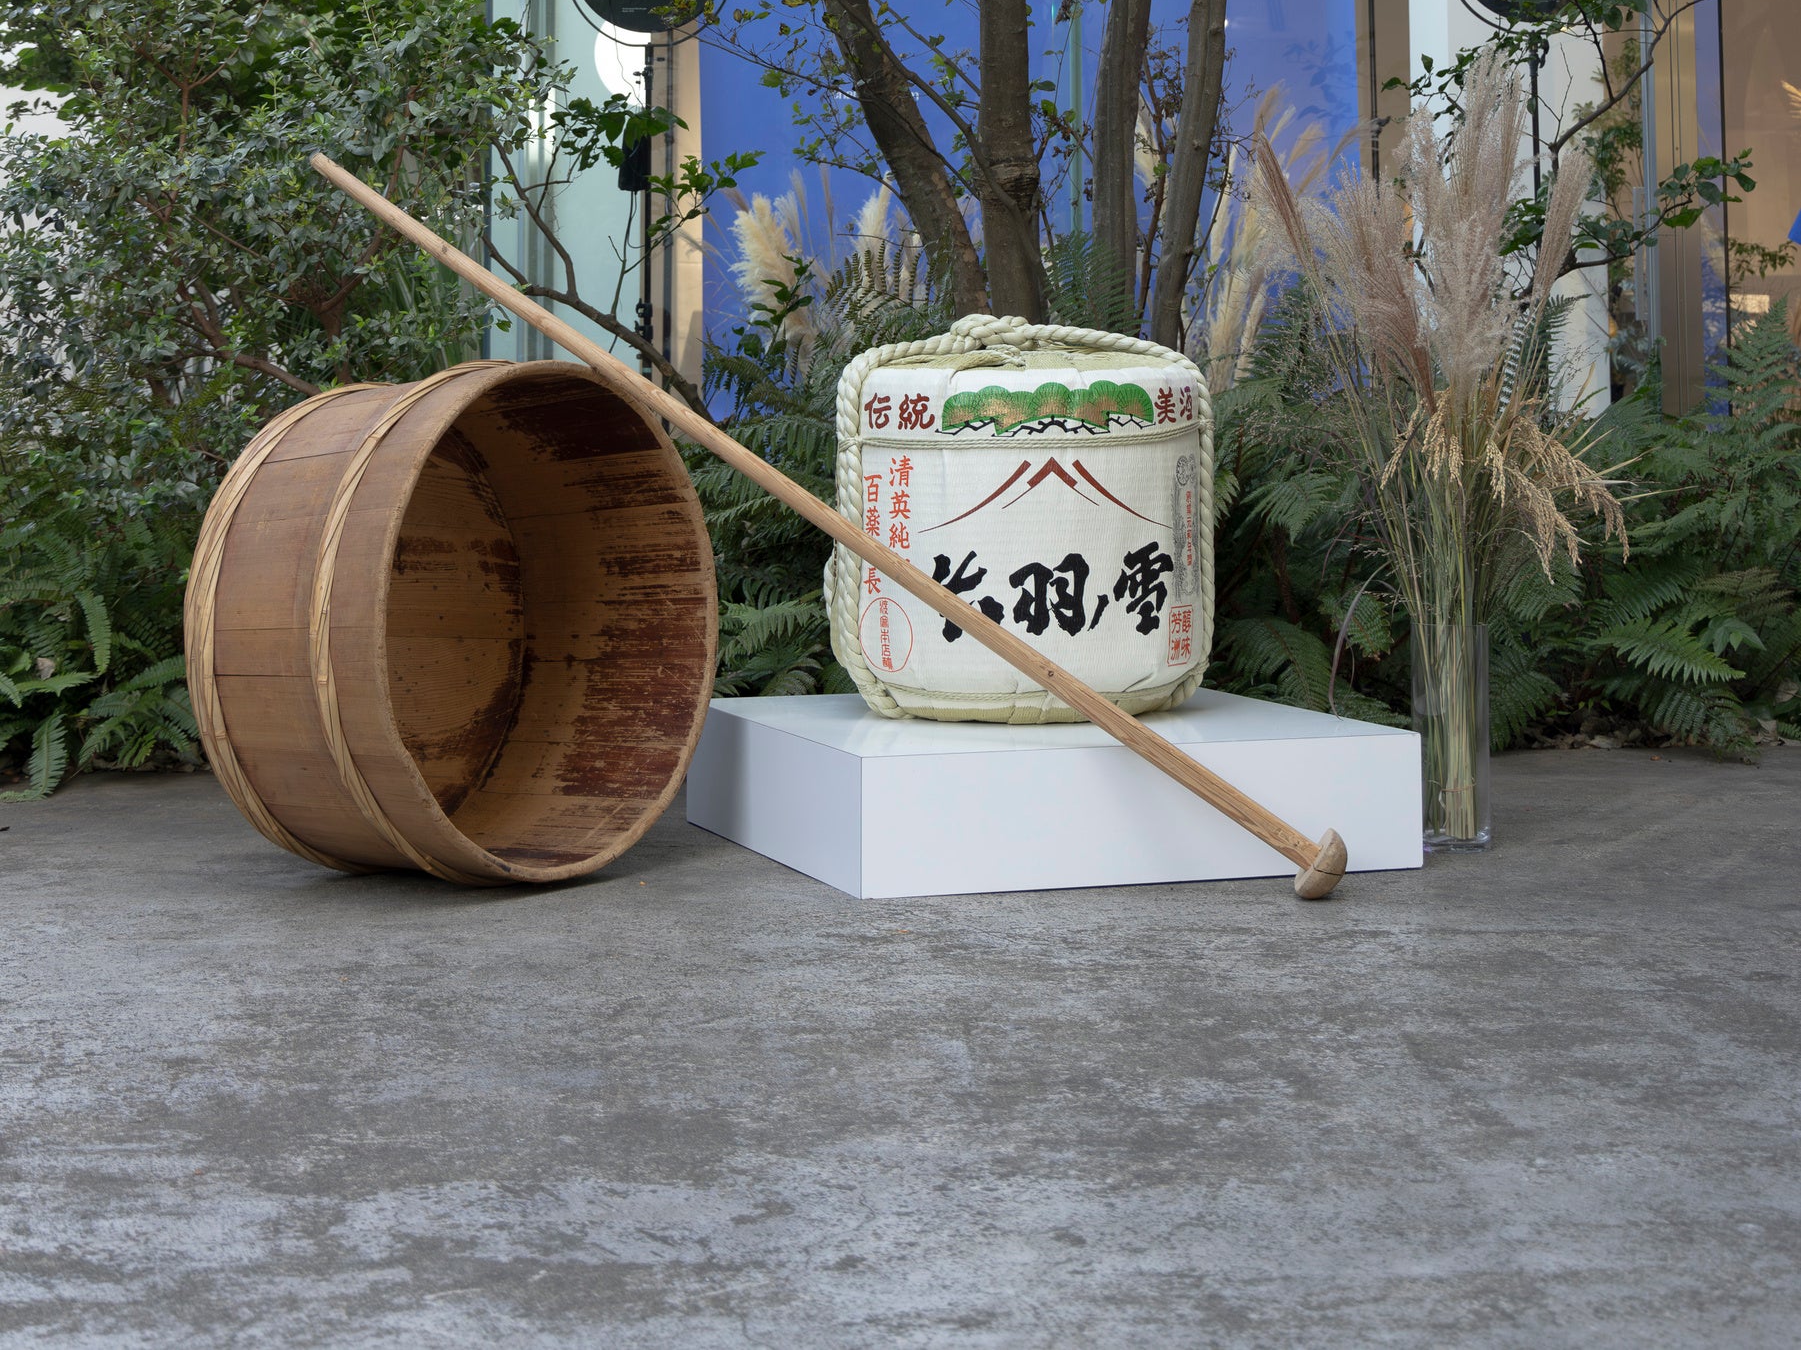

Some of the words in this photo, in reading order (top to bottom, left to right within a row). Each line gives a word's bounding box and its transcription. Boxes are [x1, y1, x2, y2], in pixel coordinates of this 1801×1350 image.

[864, 392, 935, 430] 伝統
[1154, 386, 1193, 424] 美酒
[863, 474, 883, 595] 百薬長
[889, 455, 914, 563] 清英純
